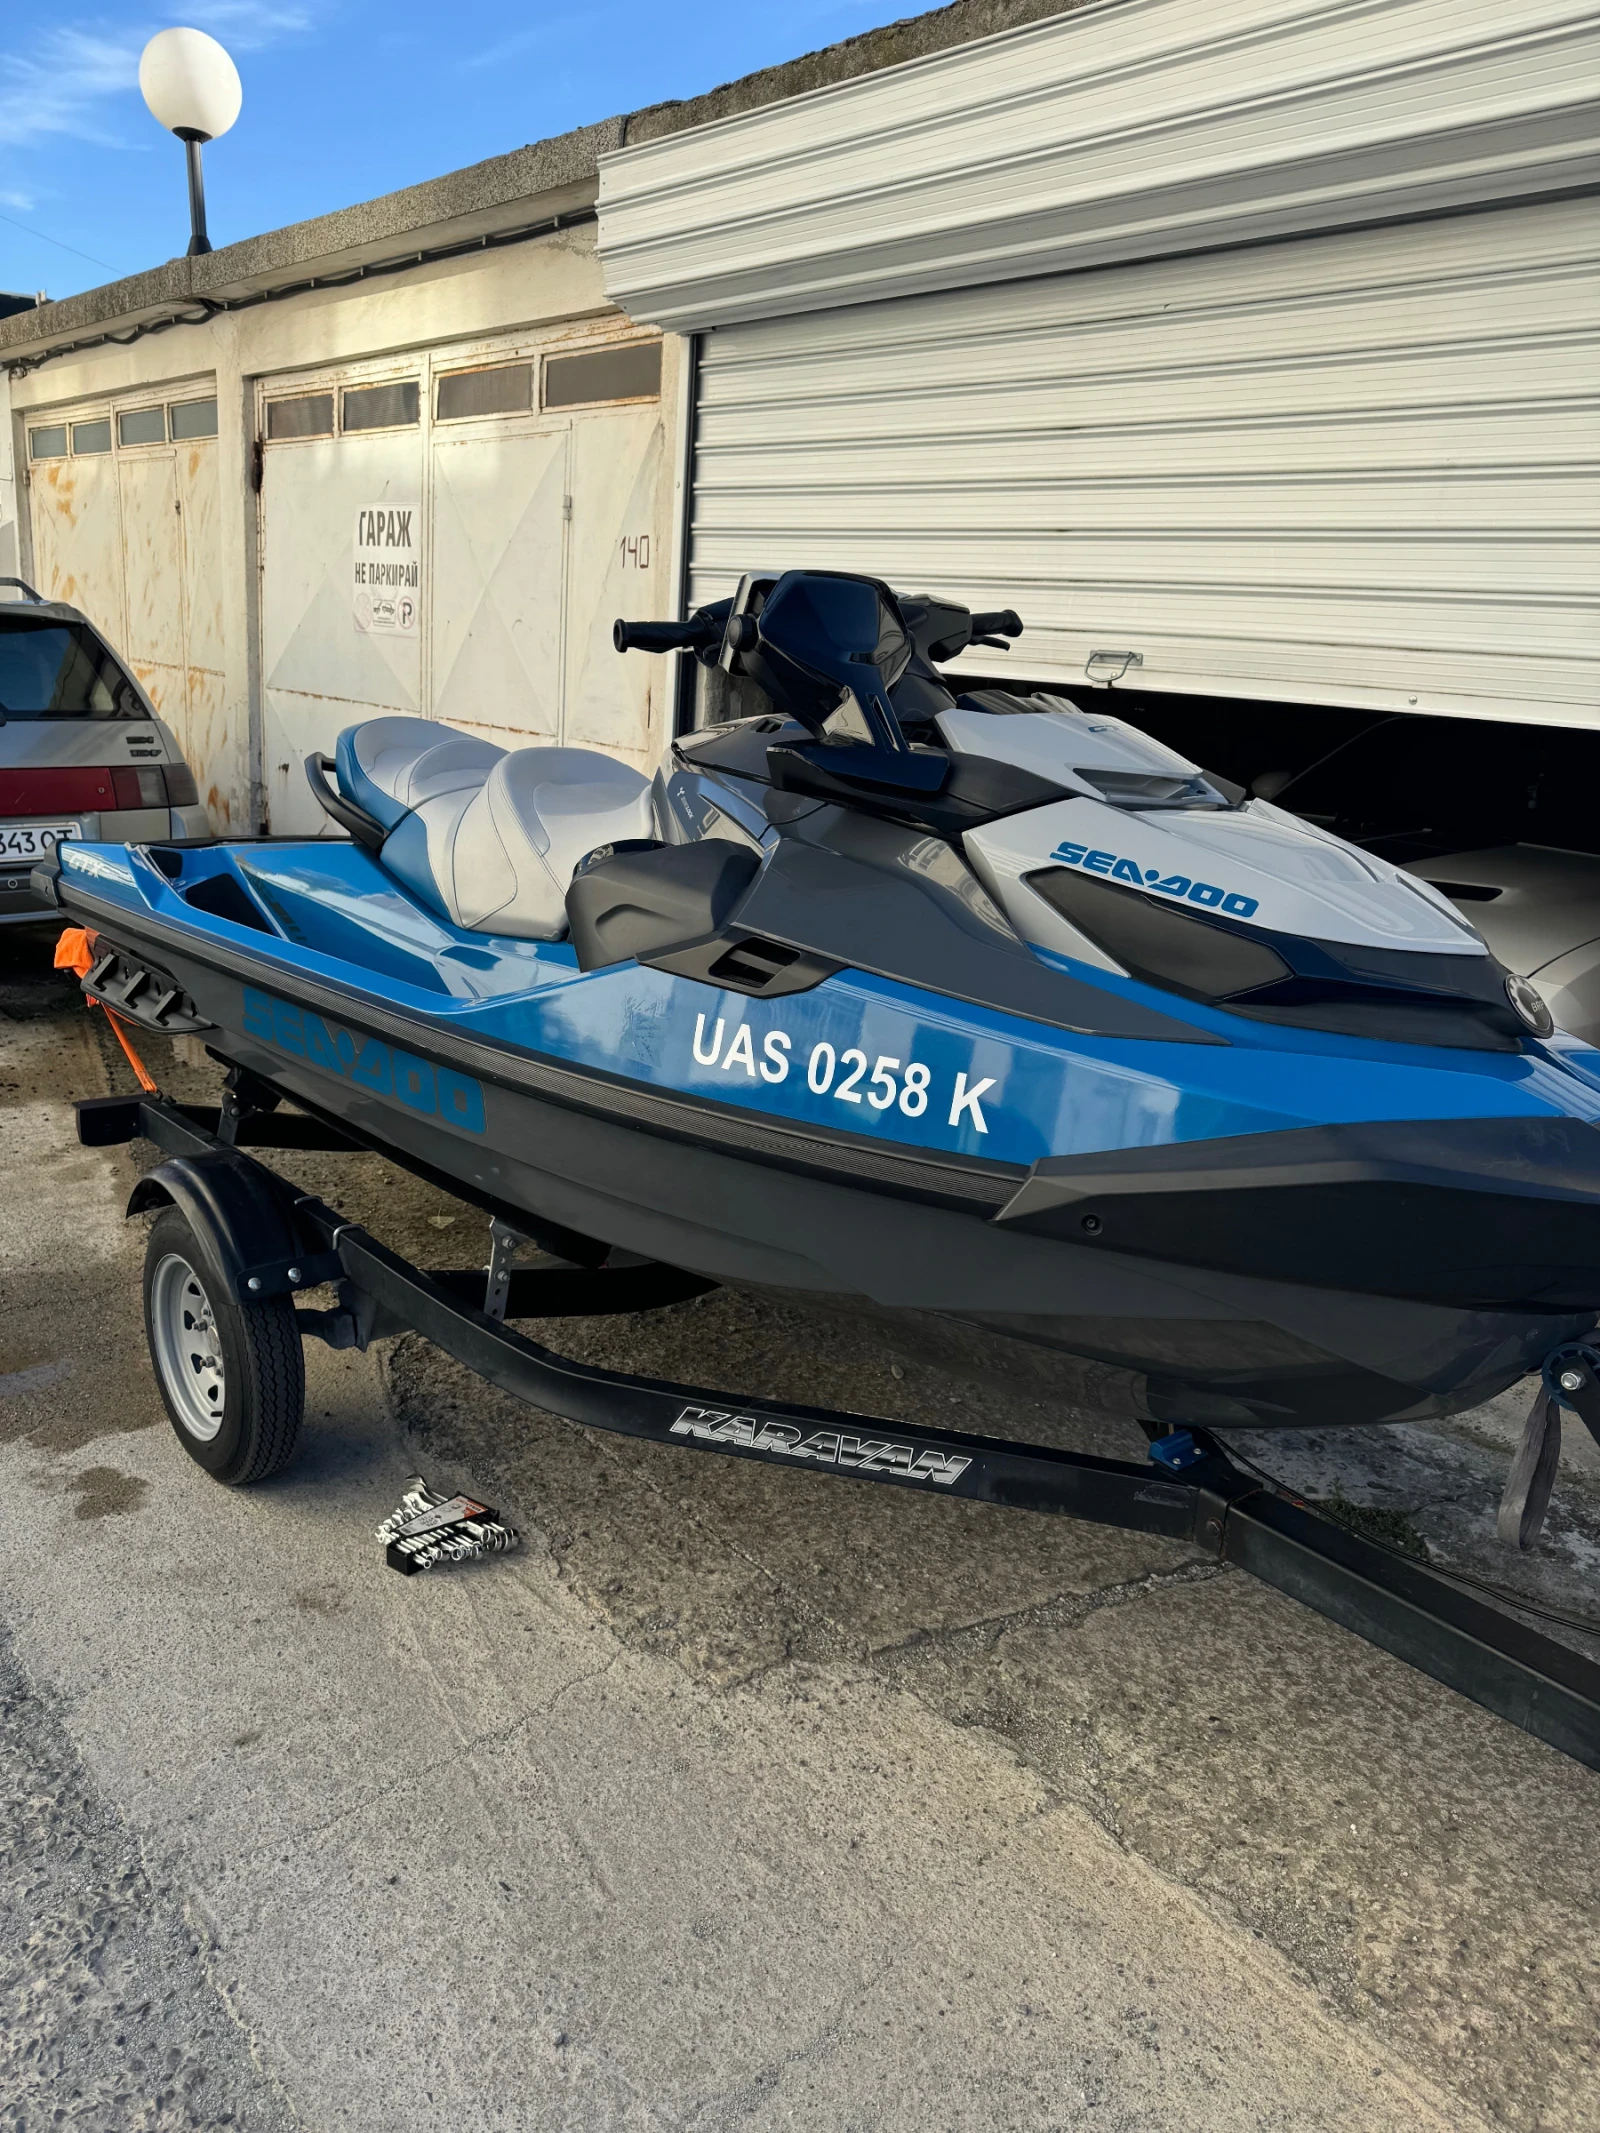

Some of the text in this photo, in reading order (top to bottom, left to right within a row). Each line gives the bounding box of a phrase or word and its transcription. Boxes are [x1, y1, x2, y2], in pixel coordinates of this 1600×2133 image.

[359, 511, 412, 547] ГАРАЖ
[620, 535, 649, 569] 140
[355, 561, 418, 587] НЕ ПАРКИРАЙ
[693, 1013, 997, 1134] UAS 0258 K
[669, 1406, 973, 1485] KARAVAN
